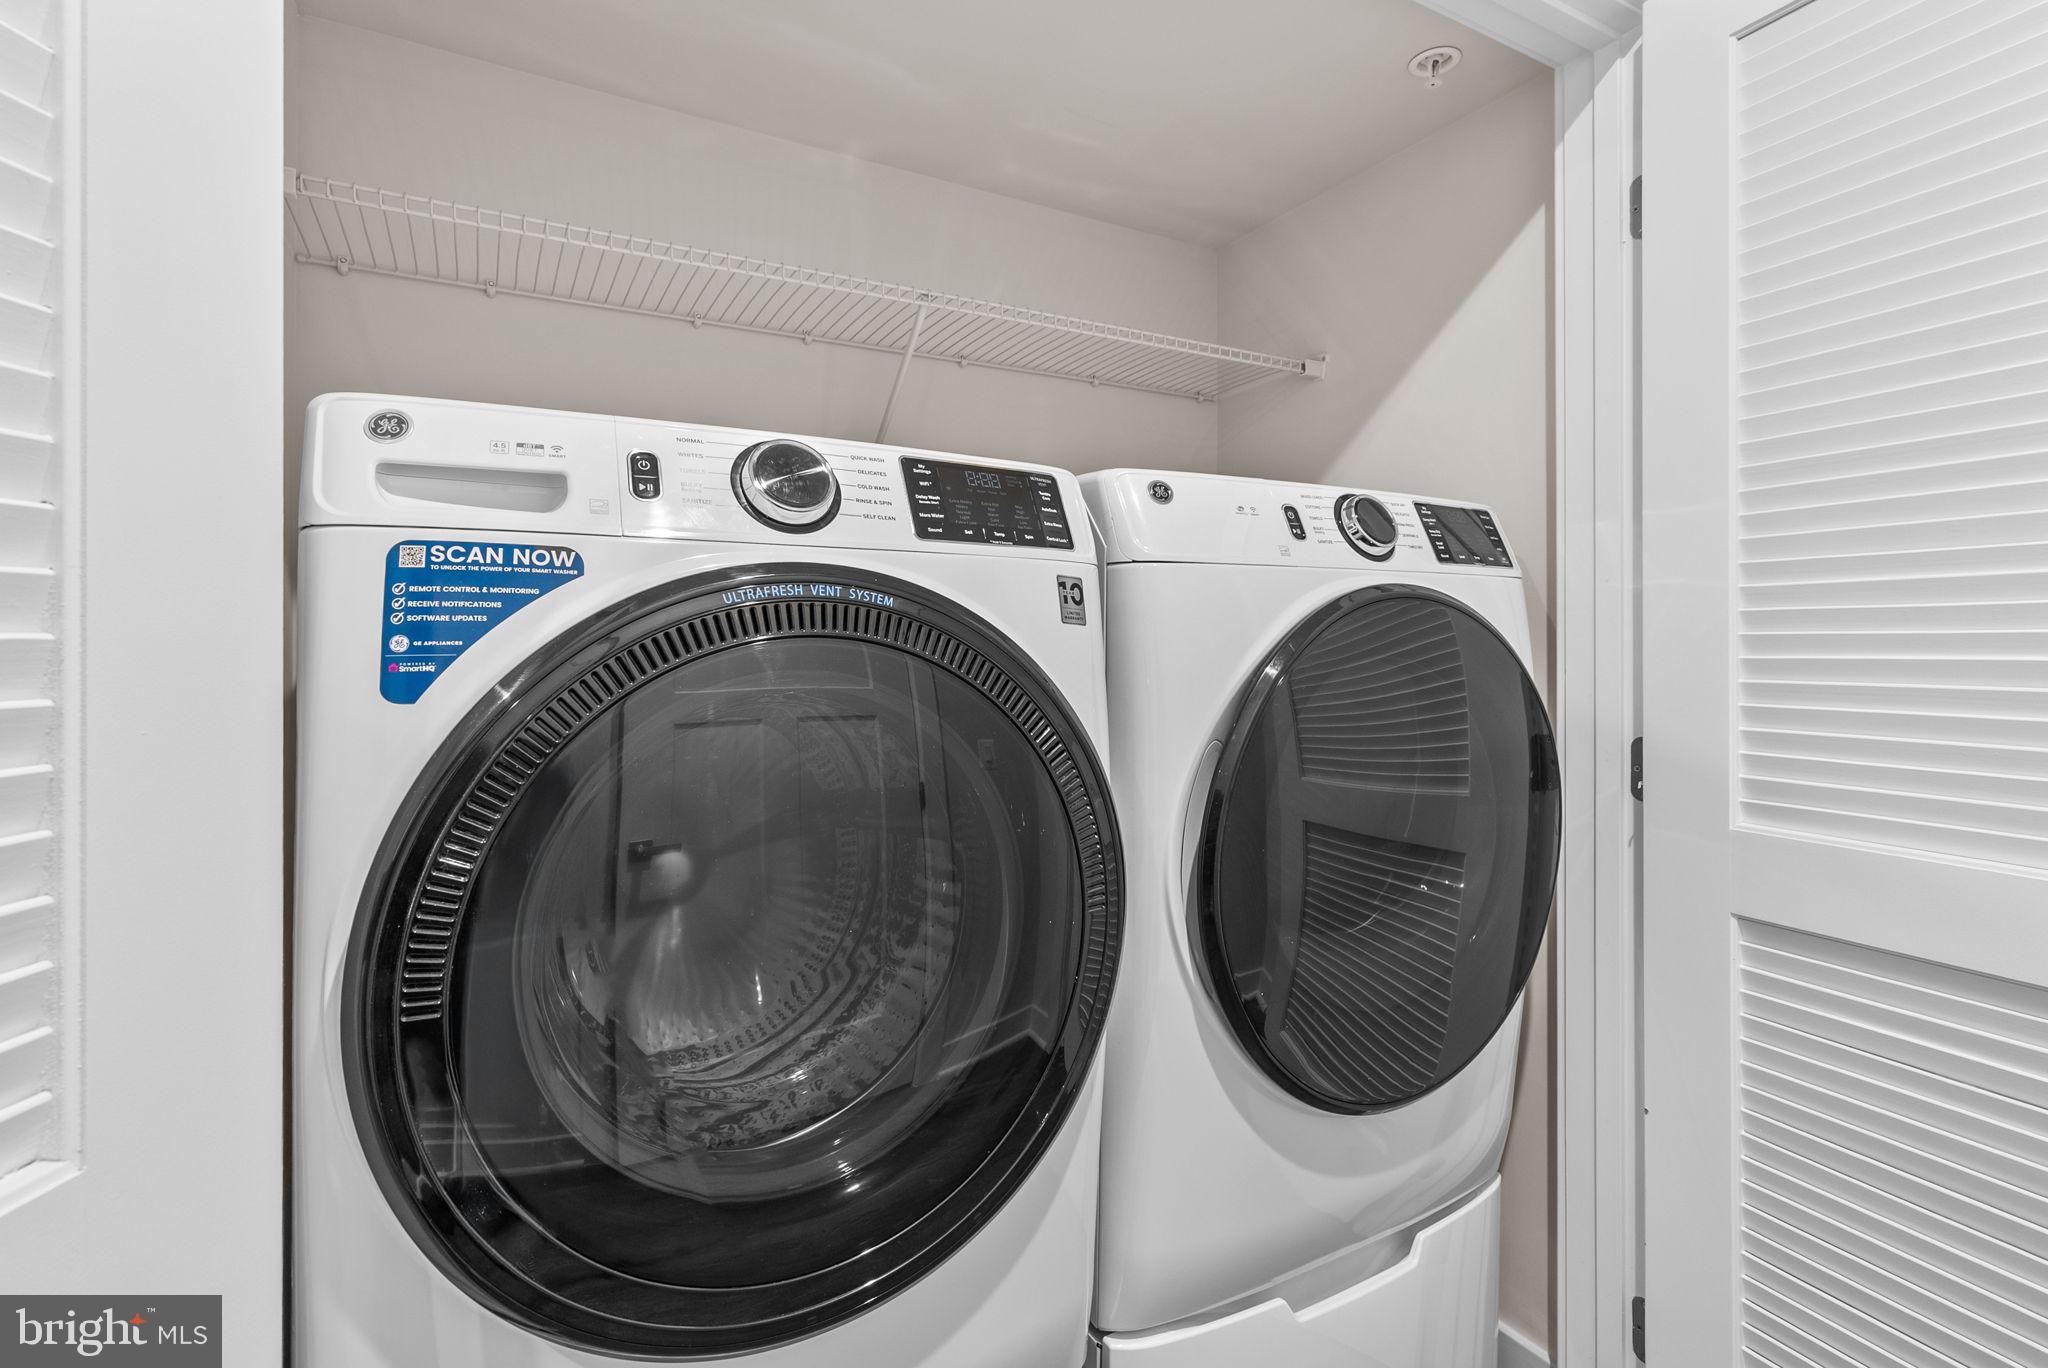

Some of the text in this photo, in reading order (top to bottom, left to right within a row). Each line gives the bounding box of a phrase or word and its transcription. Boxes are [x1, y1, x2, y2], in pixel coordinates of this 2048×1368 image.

[857, 469, 887, 477] DELICATES
[430, 545, 577, 568] SCAN NOW
[409, 585, 540, 595] REMOTE CONTROL & MONITORING
[1058, 581, 1084, 606] 10
[722, 584, 894, 607] ULTRAFRESH VENT SYSTEM
[442, 601, 502, 609] NOTIFICATIONS
[406, 614, 450, 622] SOFTWARE
[399, 665, 435, 673] SmartHQ
